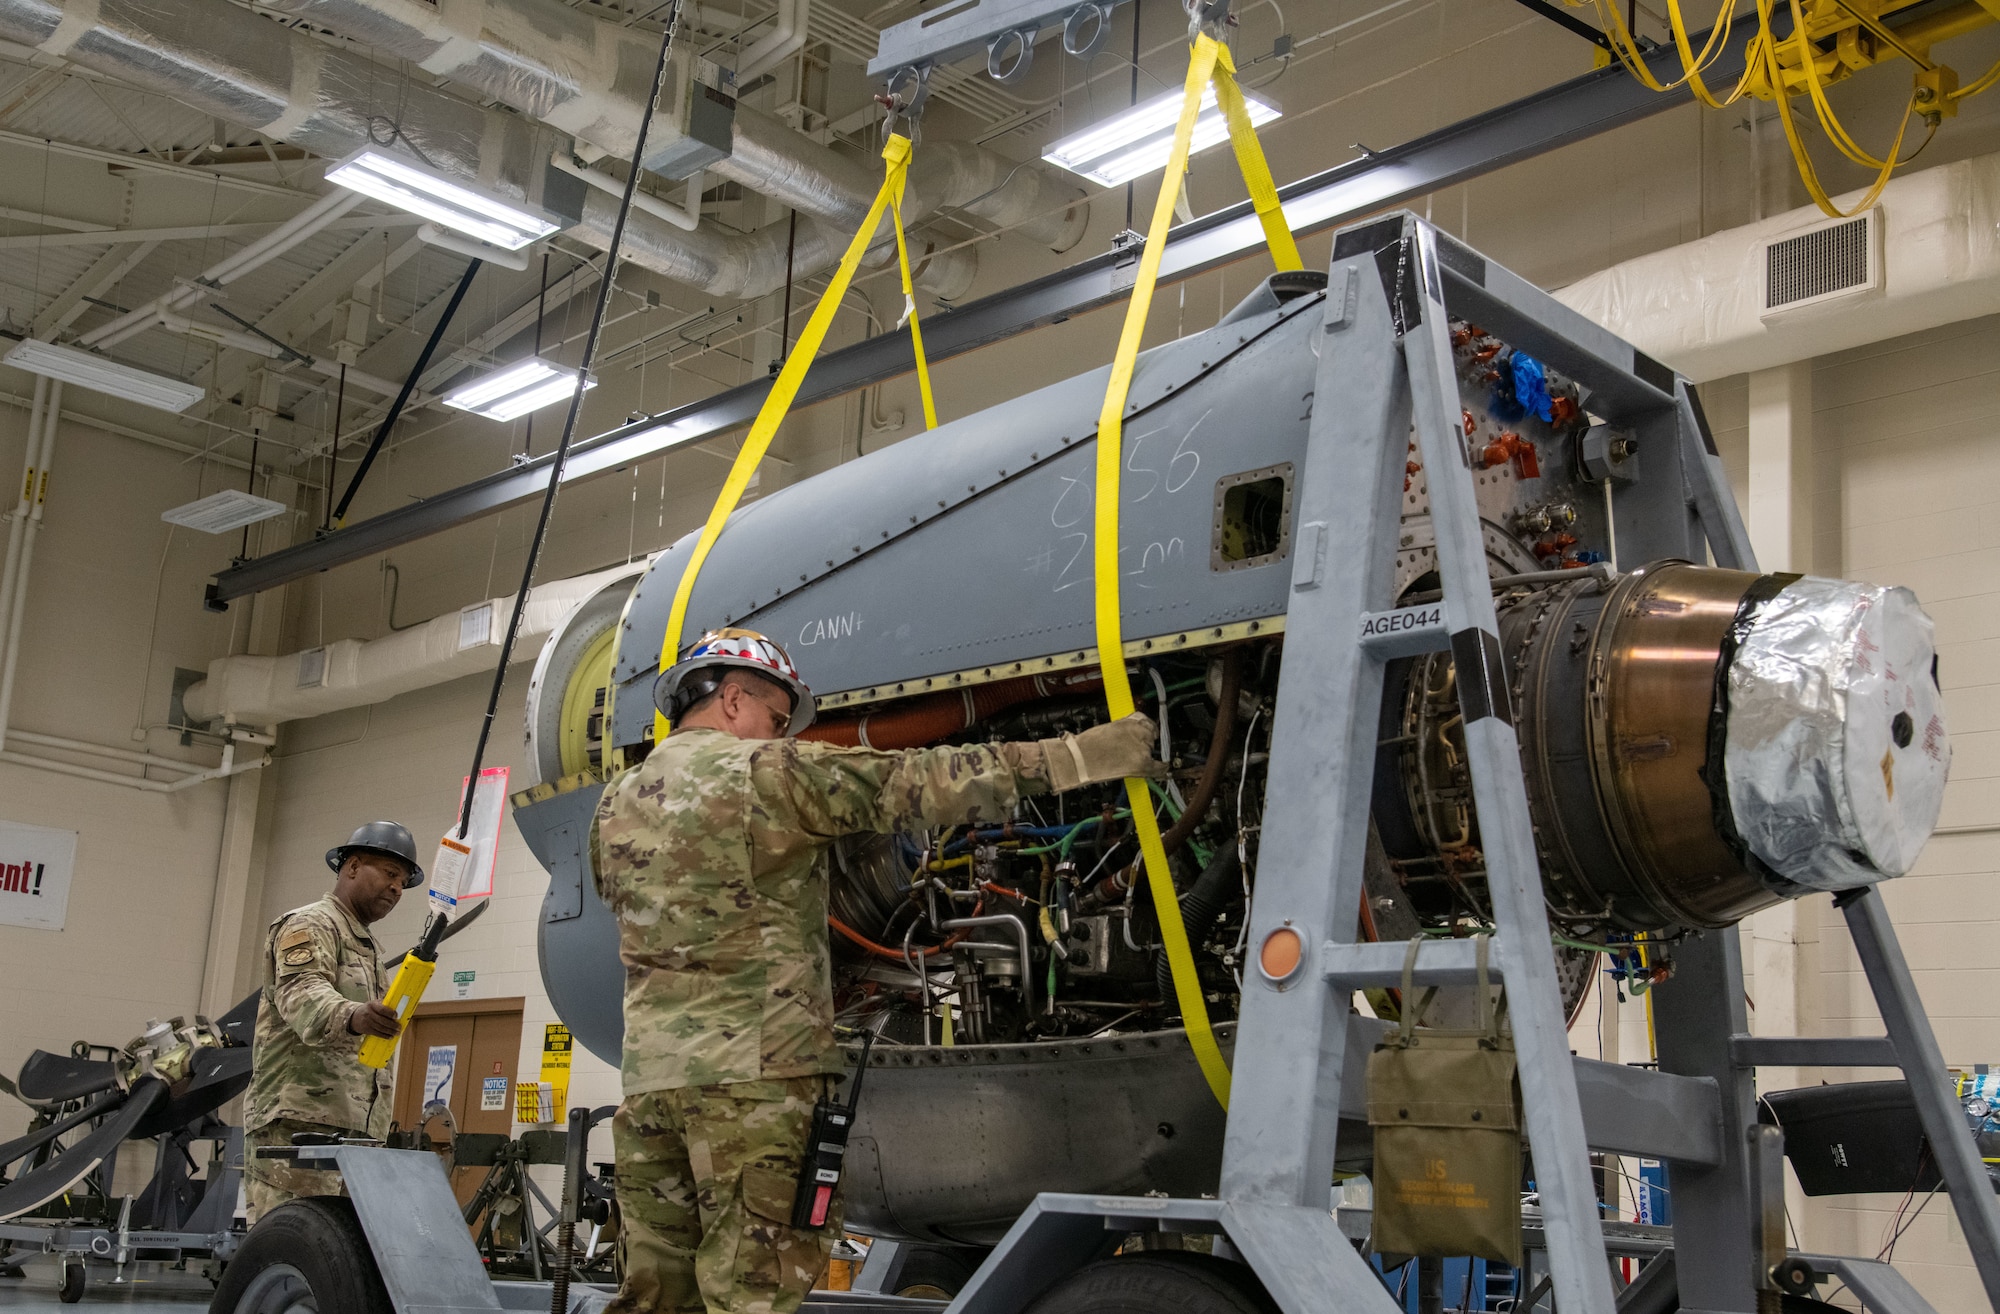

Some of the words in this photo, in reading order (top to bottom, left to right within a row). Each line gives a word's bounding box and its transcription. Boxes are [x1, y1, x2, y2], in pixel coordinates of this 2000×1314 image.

[1362, 608, 1441, 637] AGE044
[484, 1079, 507, 1089] NOTICE
[1425, 1159, 1447, 1180] US
